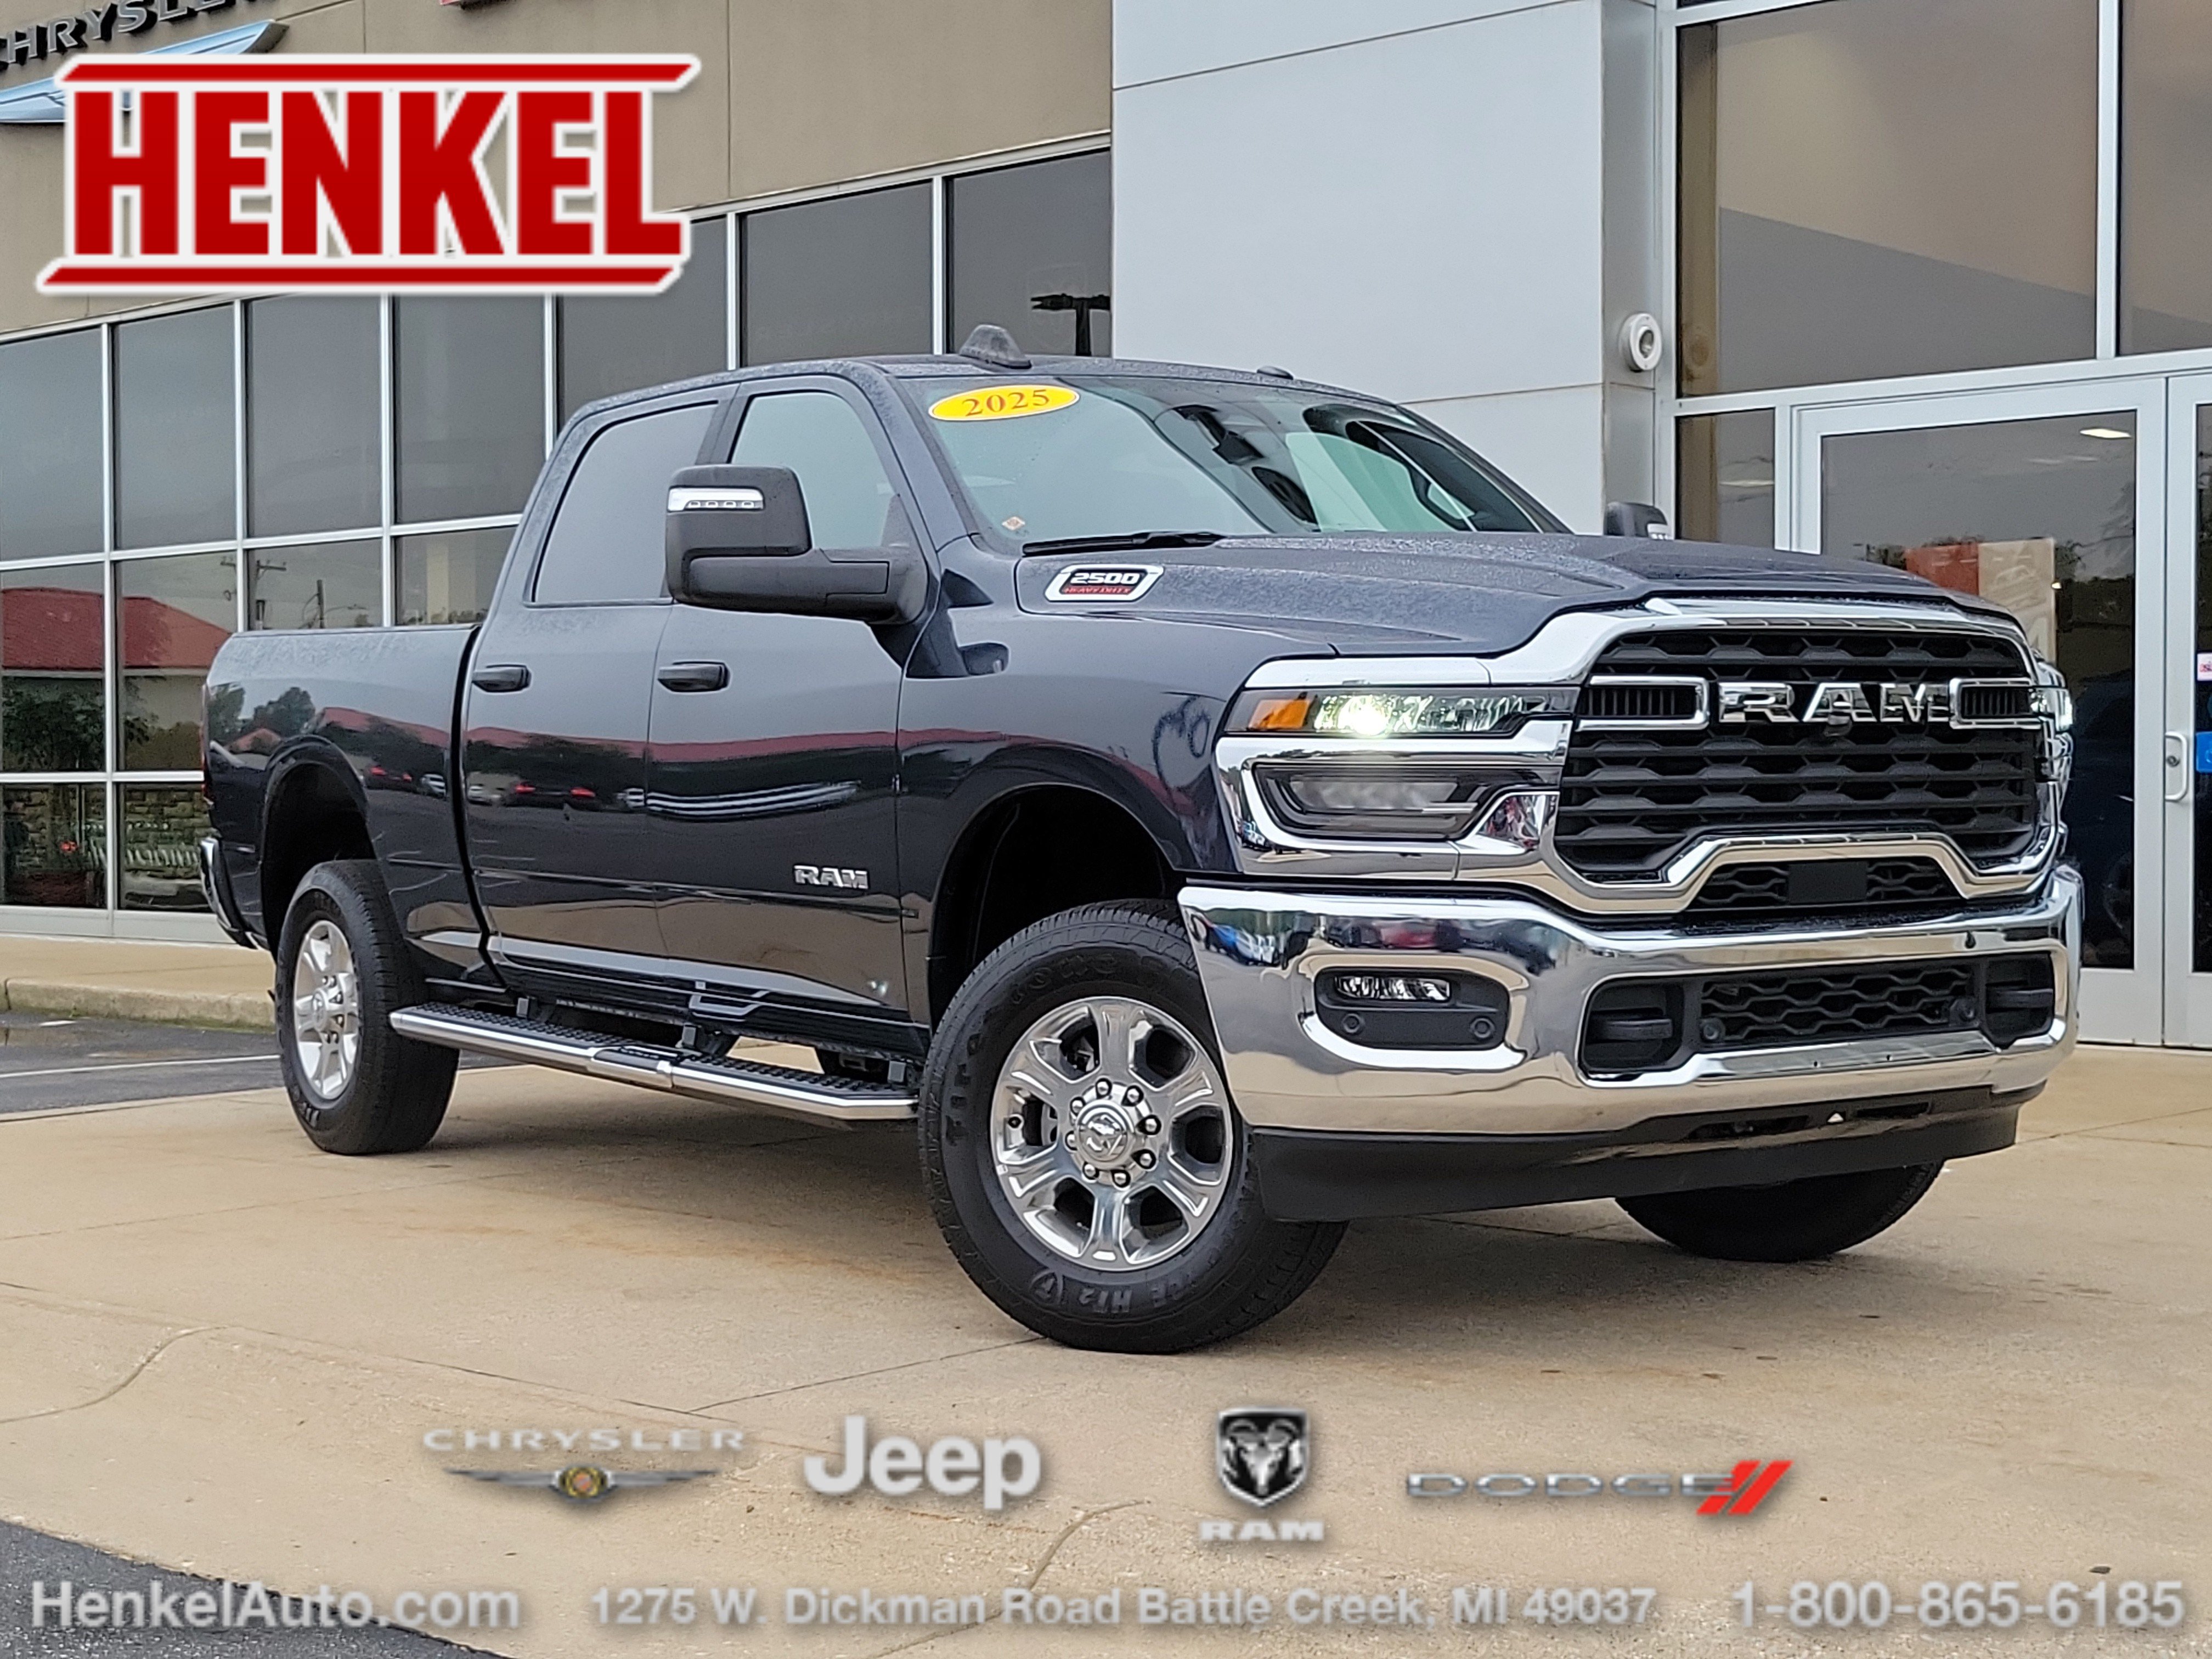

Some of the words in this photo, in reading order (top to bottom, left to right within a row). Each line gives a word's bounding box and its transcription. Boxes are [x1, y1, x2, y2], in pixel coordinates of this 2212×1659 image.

[962, 389, 1050, 417] 2025
[1070, 572, 1141, 585] 2500
[1718, 681, 1950, 724] RAM
[793, 865, 869, 890] RAM
